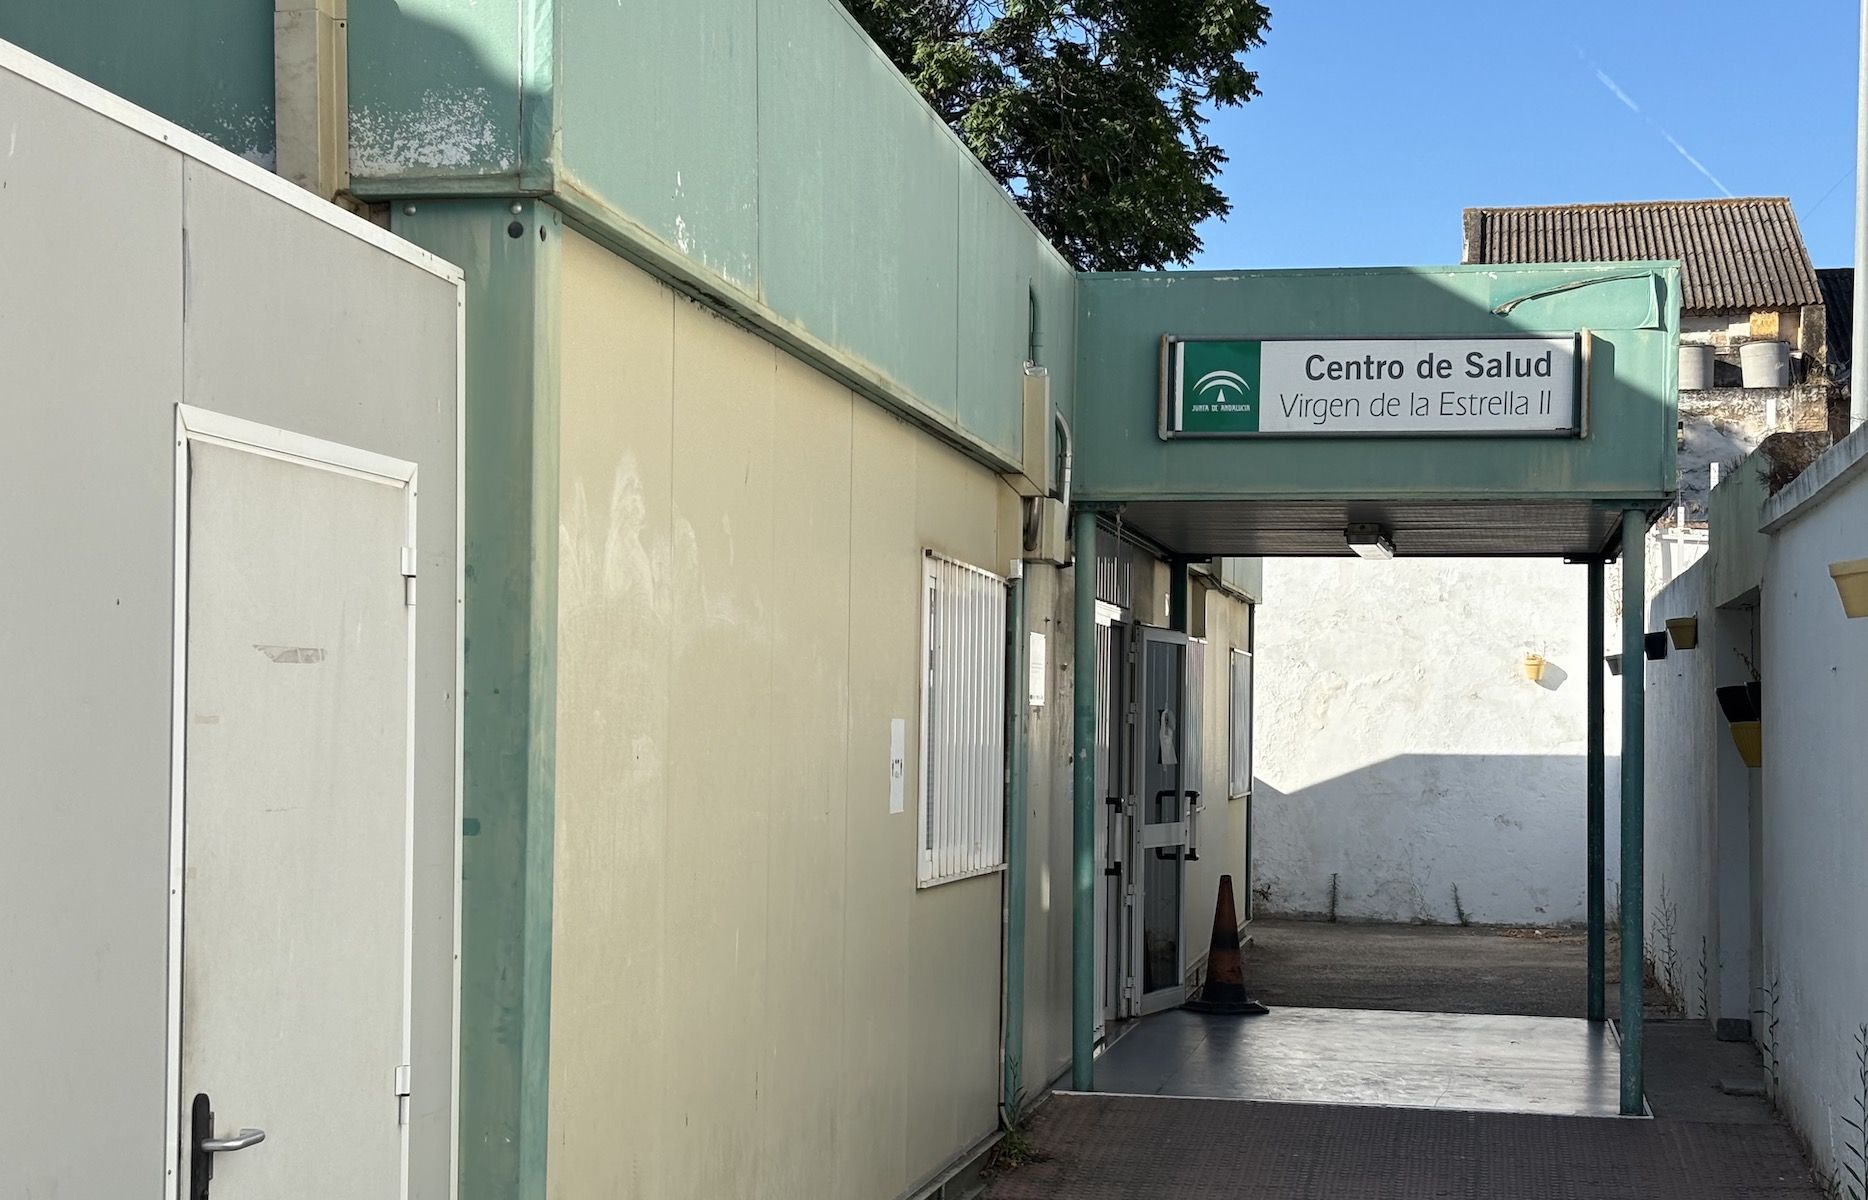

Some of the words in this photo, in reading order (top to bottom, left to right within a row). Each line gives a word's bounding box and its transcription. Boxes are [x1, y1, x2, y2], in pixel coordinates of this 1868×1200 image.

[1305, 354, 1404, 381] Centro
[1416, 352, 1453, 380] de
[1464, 350, 1552, 379] Salud
[1191, 404, 1210, 412] JUNTA
[1211, 404, 1219, 412] DE
[1279, 393, 1360, 425] Virgen
[1369, 392, 1401, 417] de
[1410, 391, 1429, 417] la
[1440, 390, 1529, 416] Estrella
[1539, 389, 1552, 415] II
